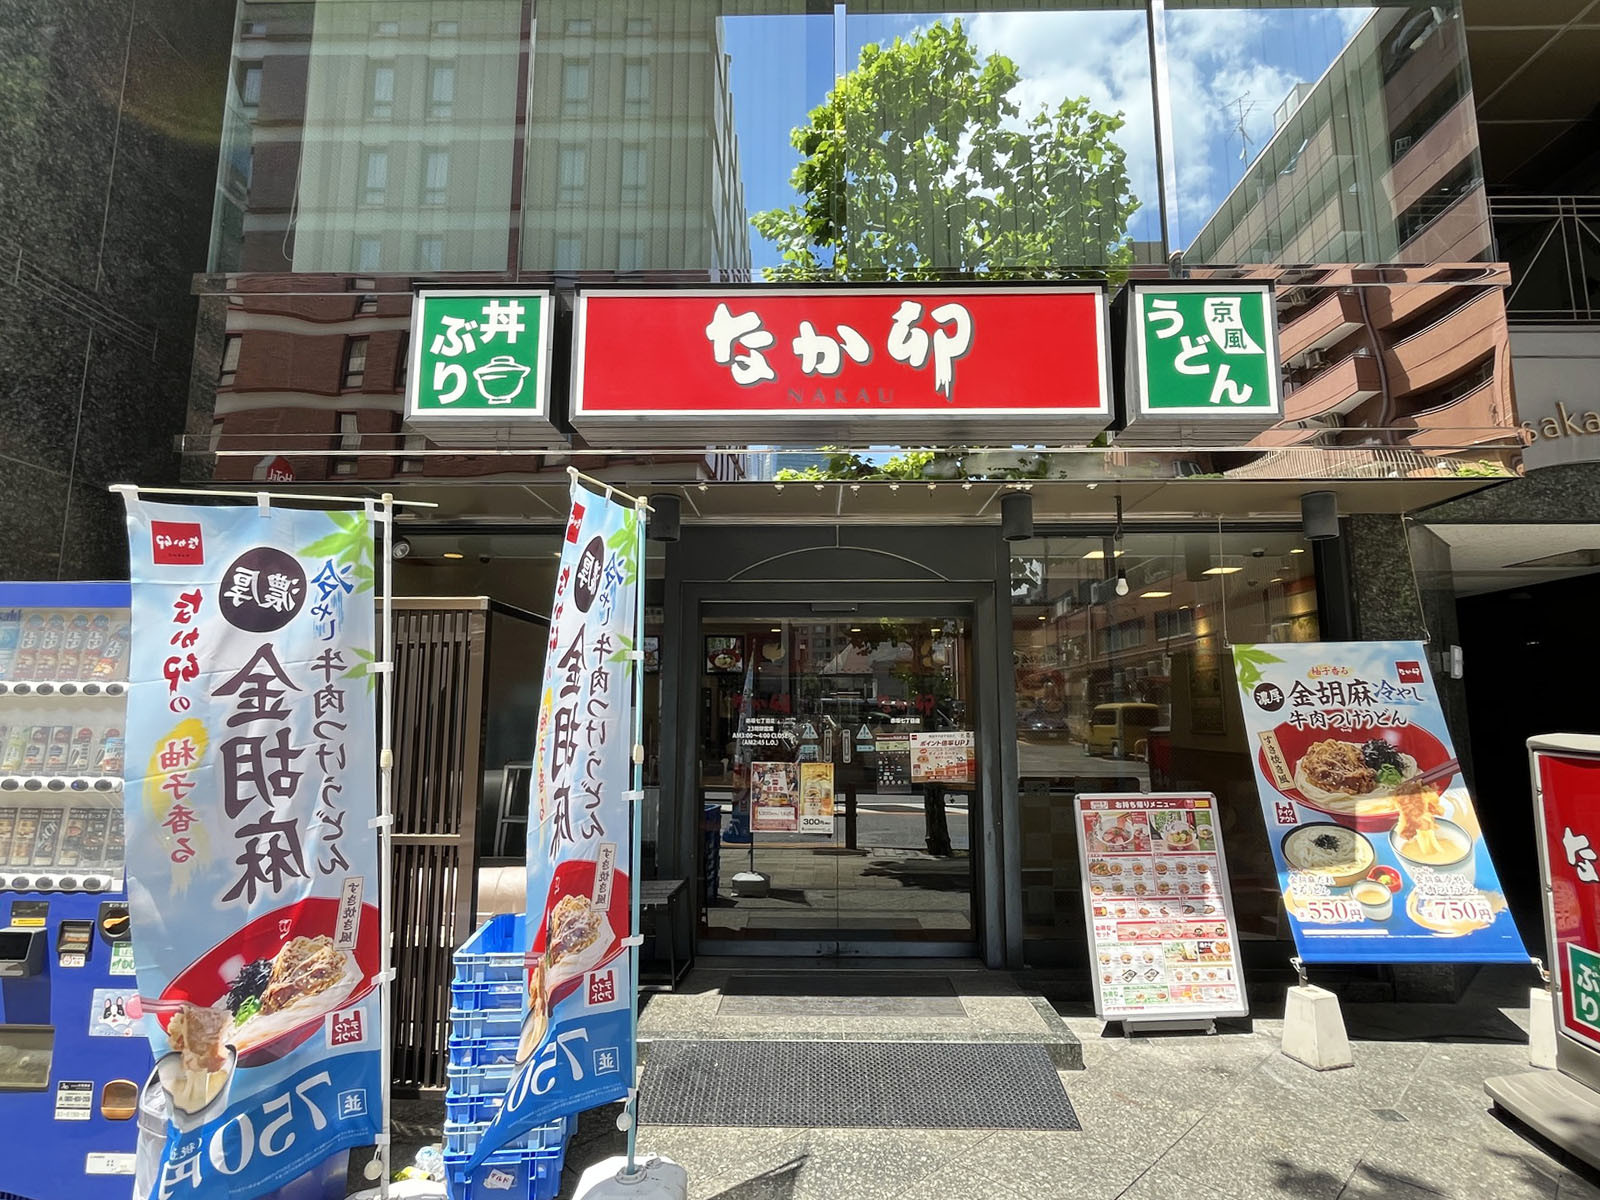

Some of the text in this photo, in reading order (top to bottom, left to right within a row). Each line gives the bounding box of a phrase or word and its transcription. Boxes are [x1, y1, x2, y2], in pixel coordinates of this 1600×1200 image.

[1211, 301, 1247, 351] 京風
[429, 299, 527, 405] 丼ぶり
[705, 301, 974, 401] なか卯
[1147, 298, 1254, 405] うどん
[787, 387, 896, 403] NAKAU
[1309, 666, 1349, 677] 柚子香る
[1255, 678, 1425, 708] 濃厚 金胡麻 冷やし
[1289, 708, 1408, 729] 牛肉つけうどん
[1262, 734, 1291, 784] すき焼き風
[1277, 808, 1294, 818] テイク
[1278, 815, 1296, 824] アウト
[1308, 901, 1363, 920] 550円
[1434, 901, 1493, 920] 750円
